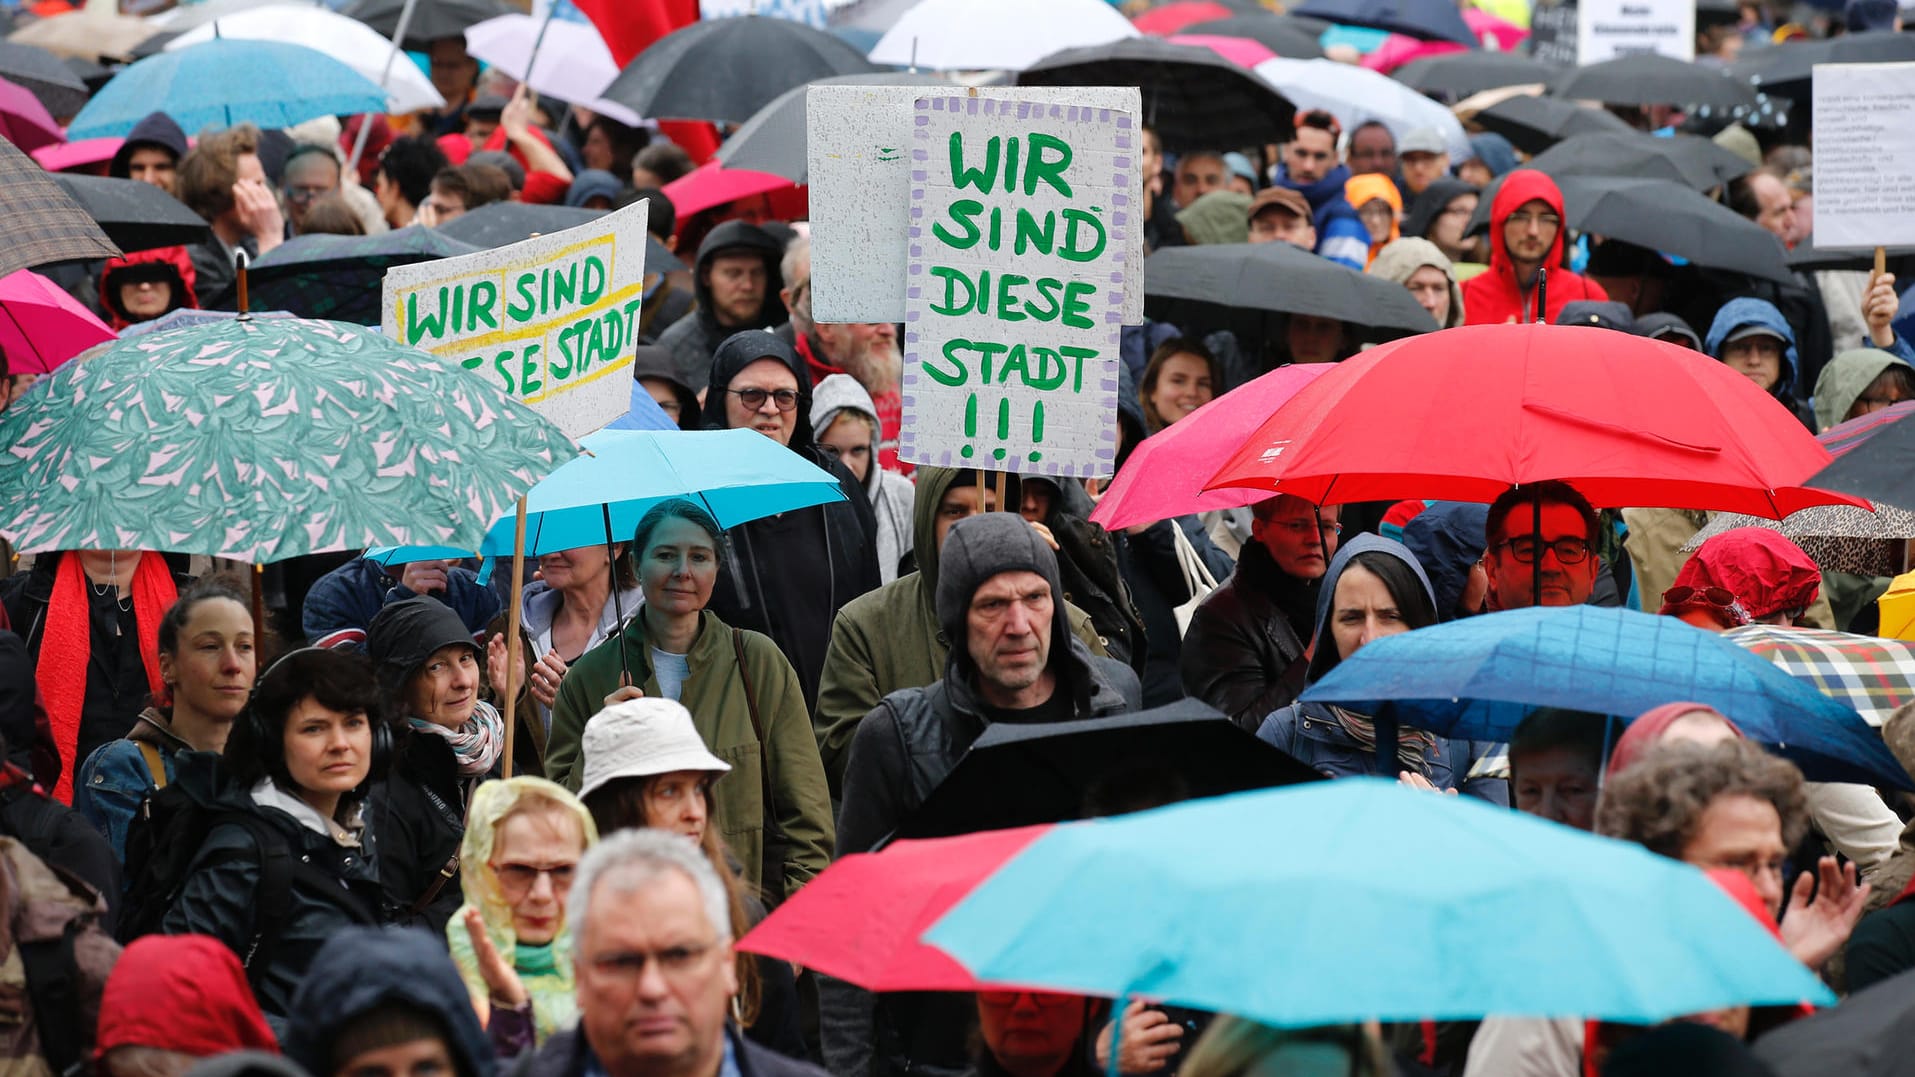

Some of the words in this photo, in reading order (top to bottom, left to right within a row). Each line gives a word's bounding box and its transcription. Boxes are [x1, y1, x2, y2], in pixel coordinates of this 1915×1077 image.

[950, 132, 1072, 198] WIR
[932, 199, 1106, 262] SIND
[408, 281, 498, 346] WIR
[508, 256, 605, 322] SIND
[930, 266, 1096, 329] DIESE
[549, 297, 640, 380] STADT
[922, 339, 1099, 393] STADT
[961, 393, 1044, 462] !!!
